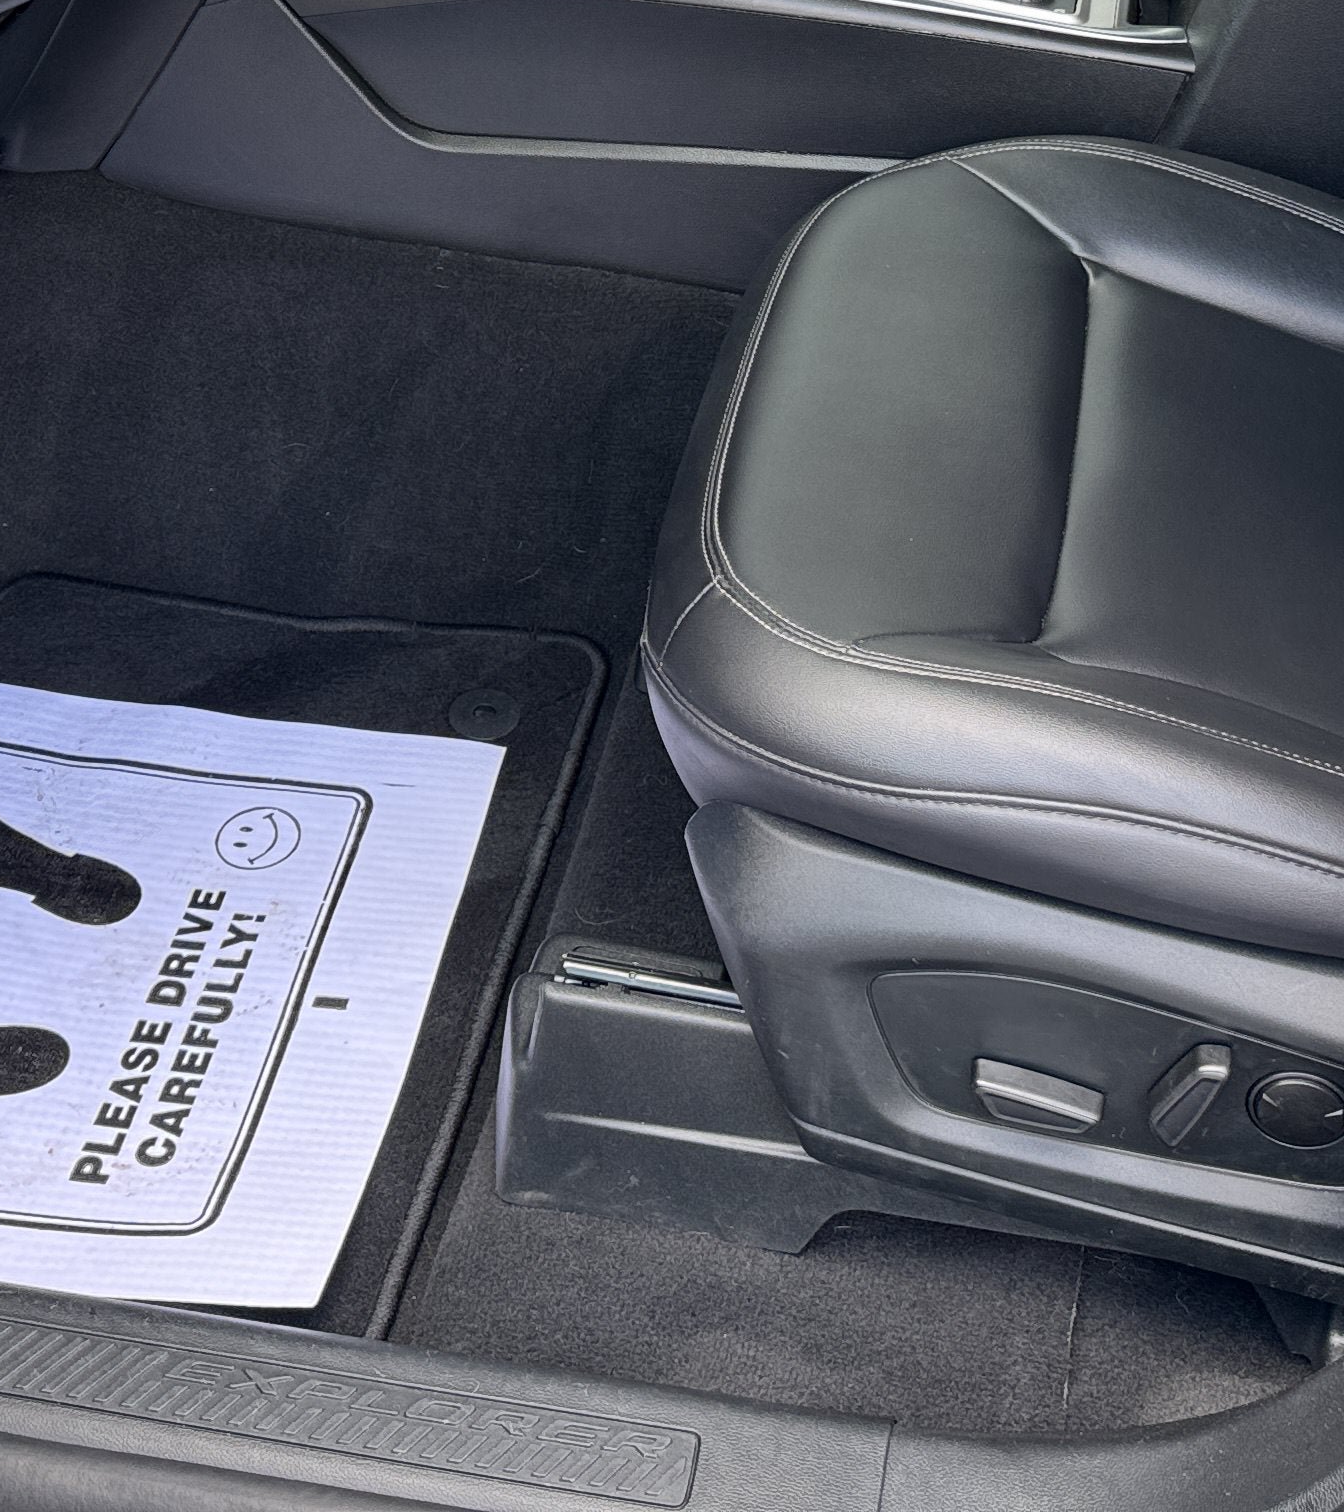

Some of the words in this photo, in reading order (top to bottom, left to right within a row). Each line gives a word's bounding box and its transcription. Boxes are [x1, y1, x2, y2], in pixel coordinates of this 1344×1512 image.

[68, 1018, 174, 1185] PLEASE
[144, 888, 227, 1008] DRIVE
[134, 912, 268, 1168] CAREFULLY!
[165, 1360, 673, 1458] EXPLORER
